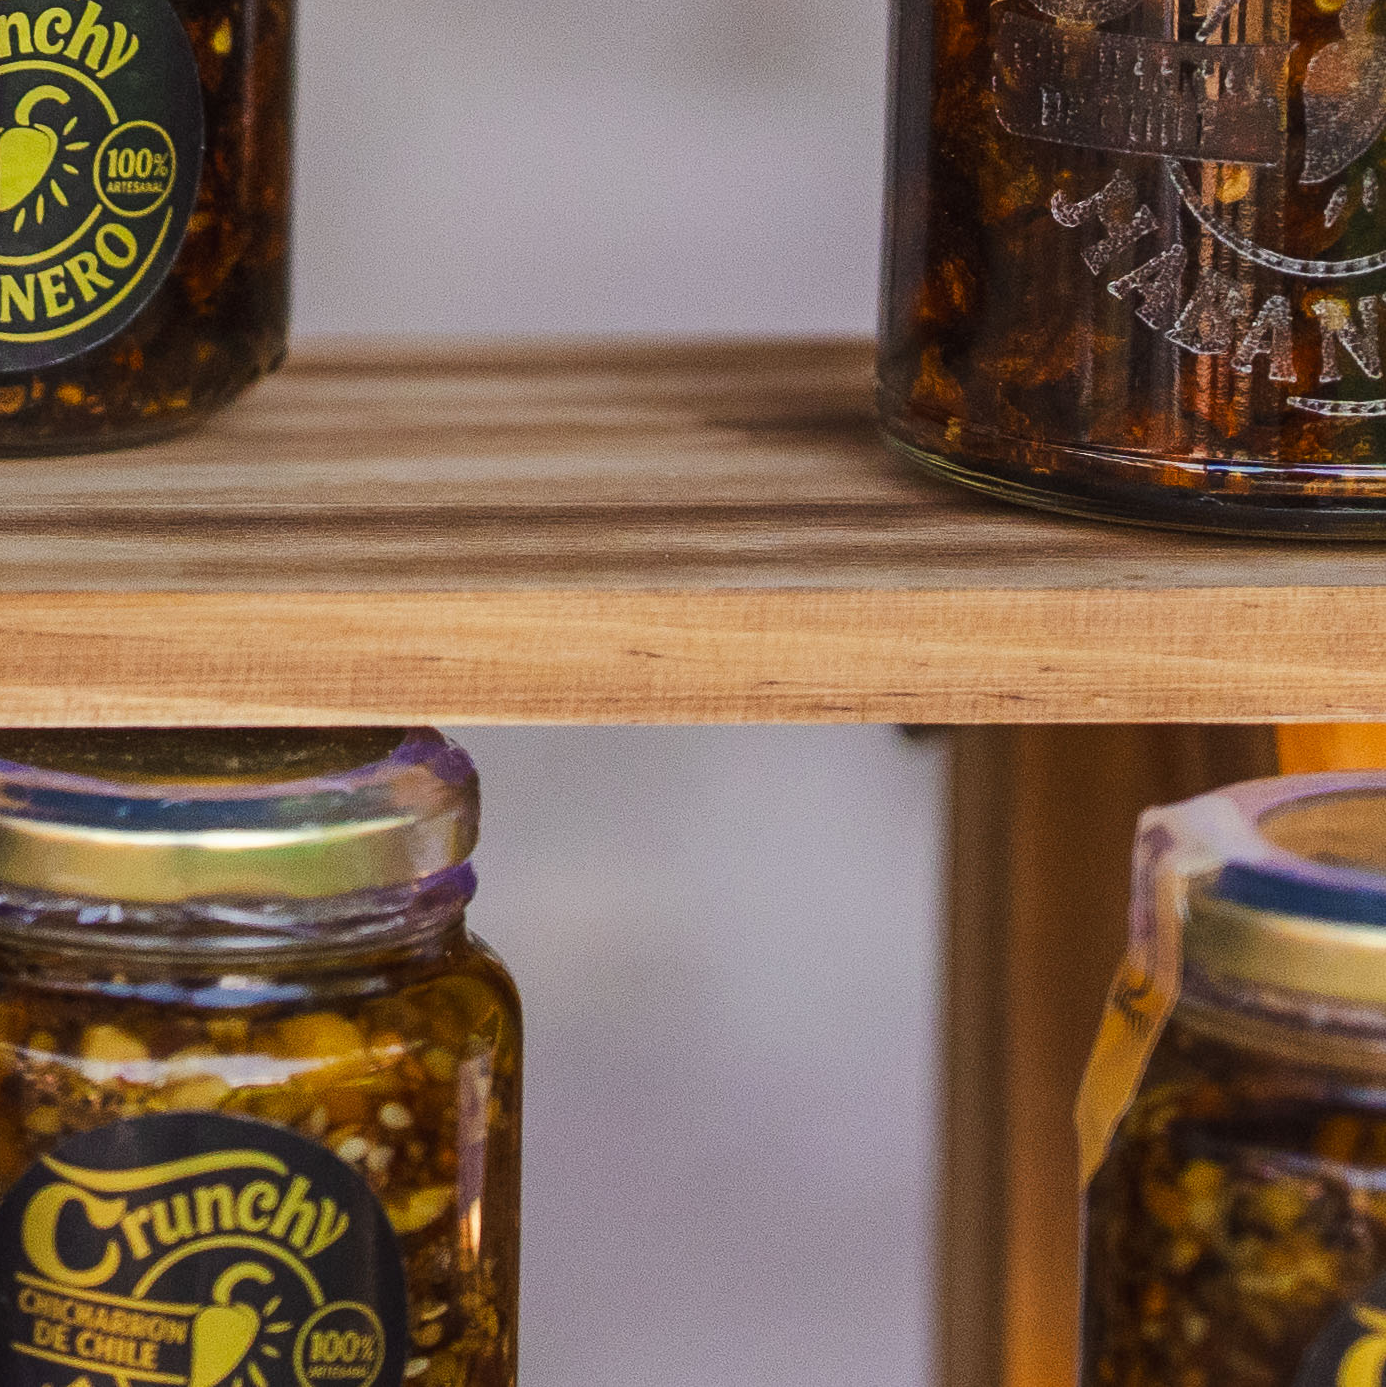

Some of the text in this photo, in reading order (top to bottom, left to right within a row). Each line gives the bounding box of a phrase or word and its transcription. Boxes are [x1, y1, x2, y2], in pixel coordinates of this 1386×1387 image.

[107, 147, 169, 180] 100%
[1050, 168, 1386, 383] HABAN
[21, 1148, 351, 1288] Crunchy
[310, 1329, 375, 1364] 100%
